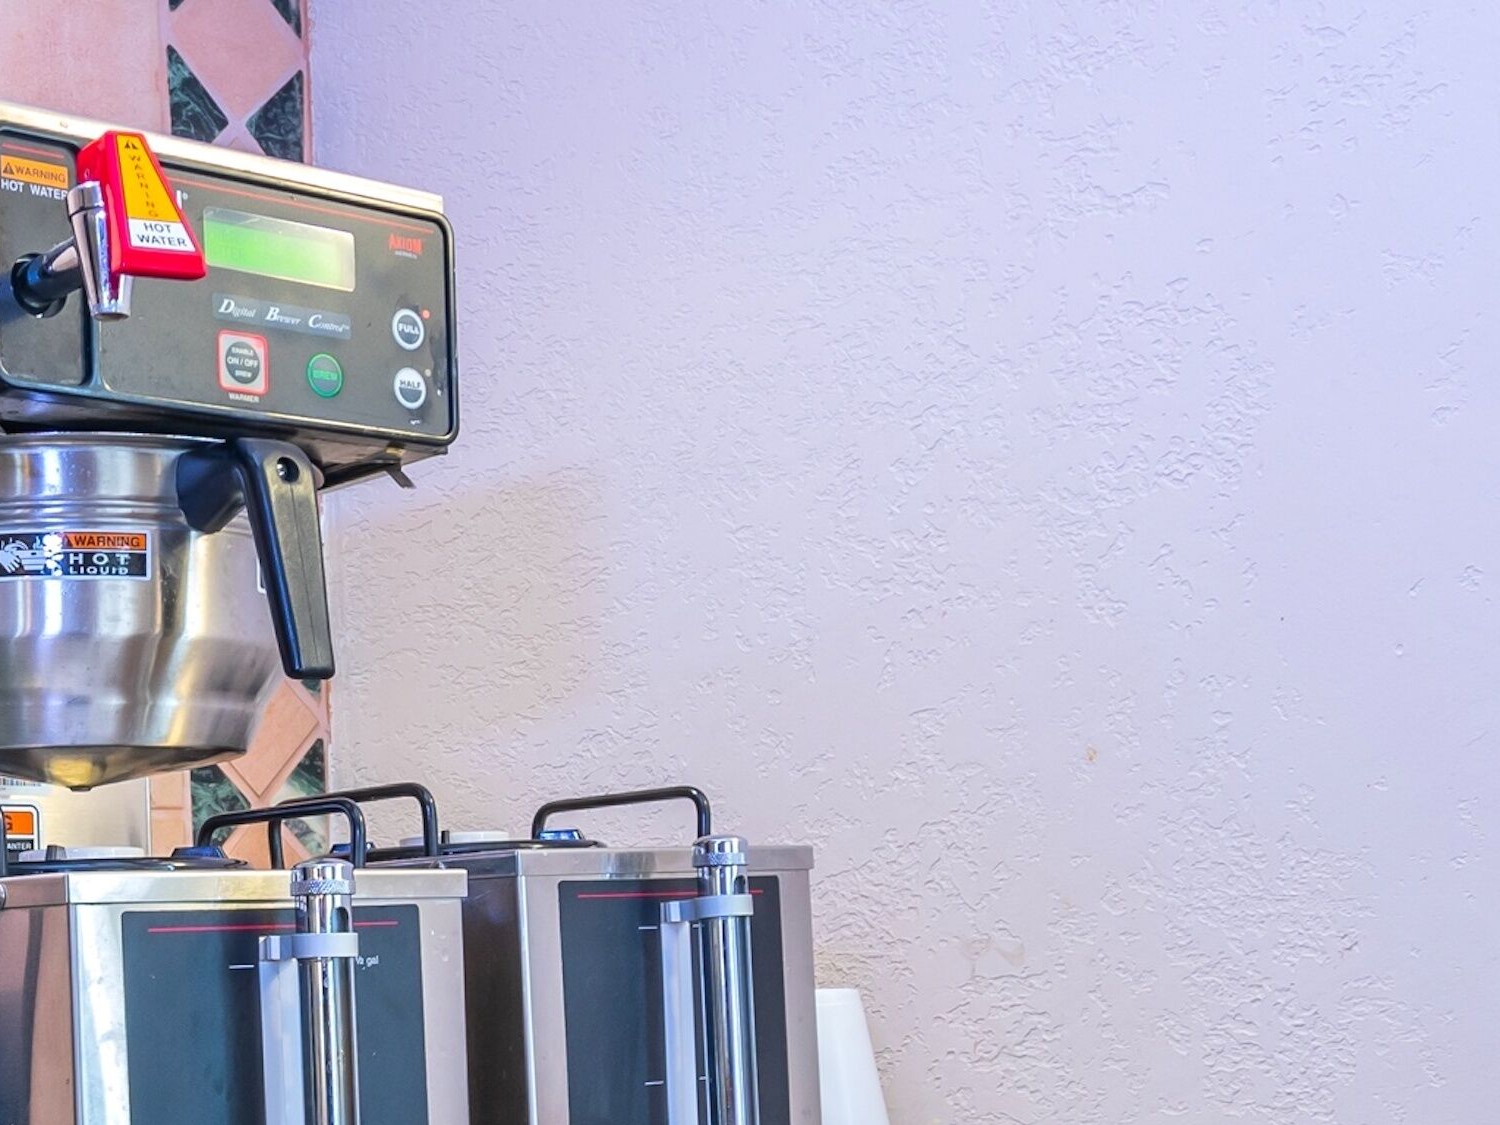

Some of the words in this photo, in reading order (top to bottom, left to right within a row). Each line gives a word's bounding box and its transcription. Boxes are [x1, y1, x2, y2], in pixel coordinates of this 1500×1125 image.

[14, 165, 66, 183] WARNING
[1, 178, 25, 193] HOT
[129, 155, 159, 217] WARNING
[142, 221, 172, 235] HOT
[137, 233, 188, 248] WATER
[388, 233, 422, 254] AXIOM
[218, 298, 257, 319] Digital
[265, 305, 301, 325] Brewer
[398, 322, 419, 335] FULL
[399, 378, 422, 390] HALF
[228, 392, 260, 403] WARMER
[75, 534, 140, 548] WARNING
[69, 553, 130, 566] HOT
[69, 566, 129, 576] LIQUID
[366, 955, 378, 967] gal
